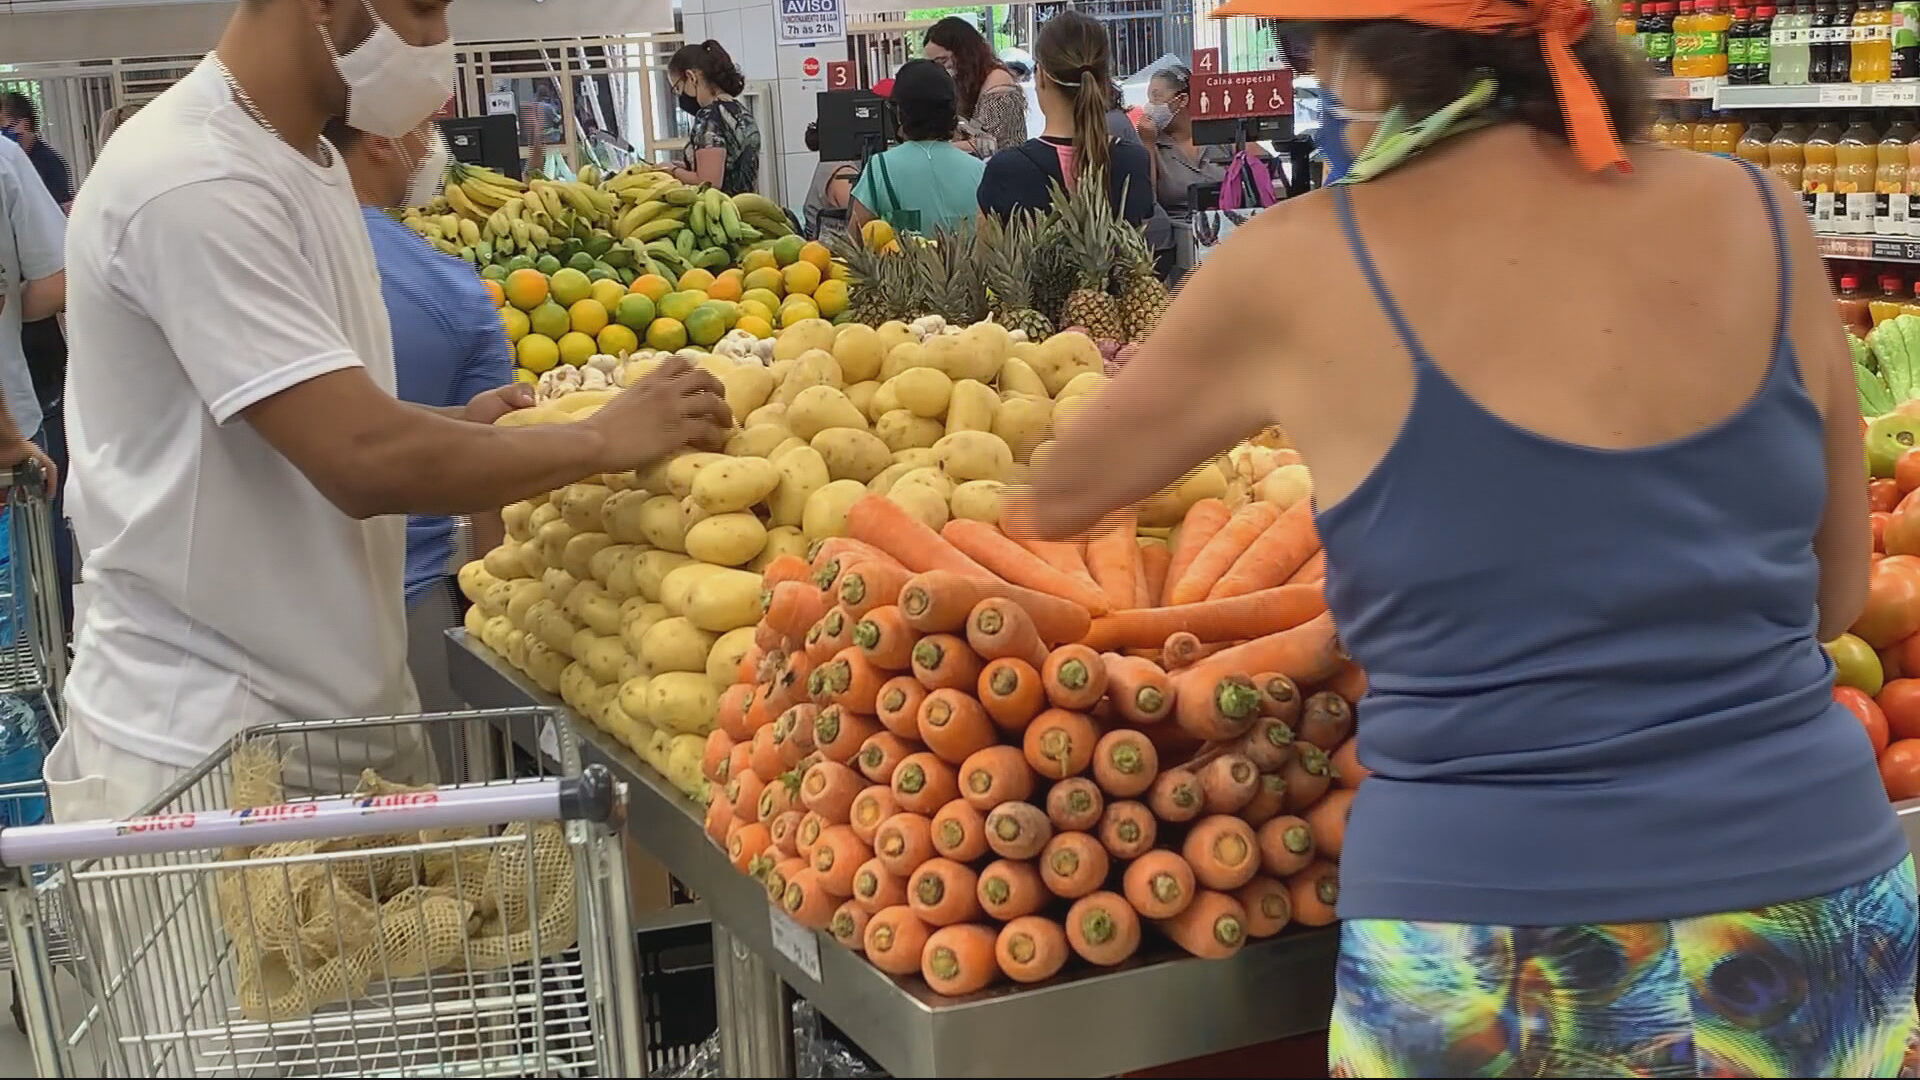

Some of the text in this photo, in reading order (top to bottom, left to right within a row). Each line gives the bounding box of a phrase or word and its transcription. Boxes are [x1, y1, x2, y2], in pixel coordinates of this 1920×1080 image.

[787, 0, 833, 13] AVISO
[787, 25, 800, 34] 7h
[816, 23, 834, 33] 21h
[1199, 52, 1212, 71] 4
[835, 66, 847, 86] 3
[1206, 73, 1276, 86] Caixa especial
[371, 792, 439, 813] ultra
